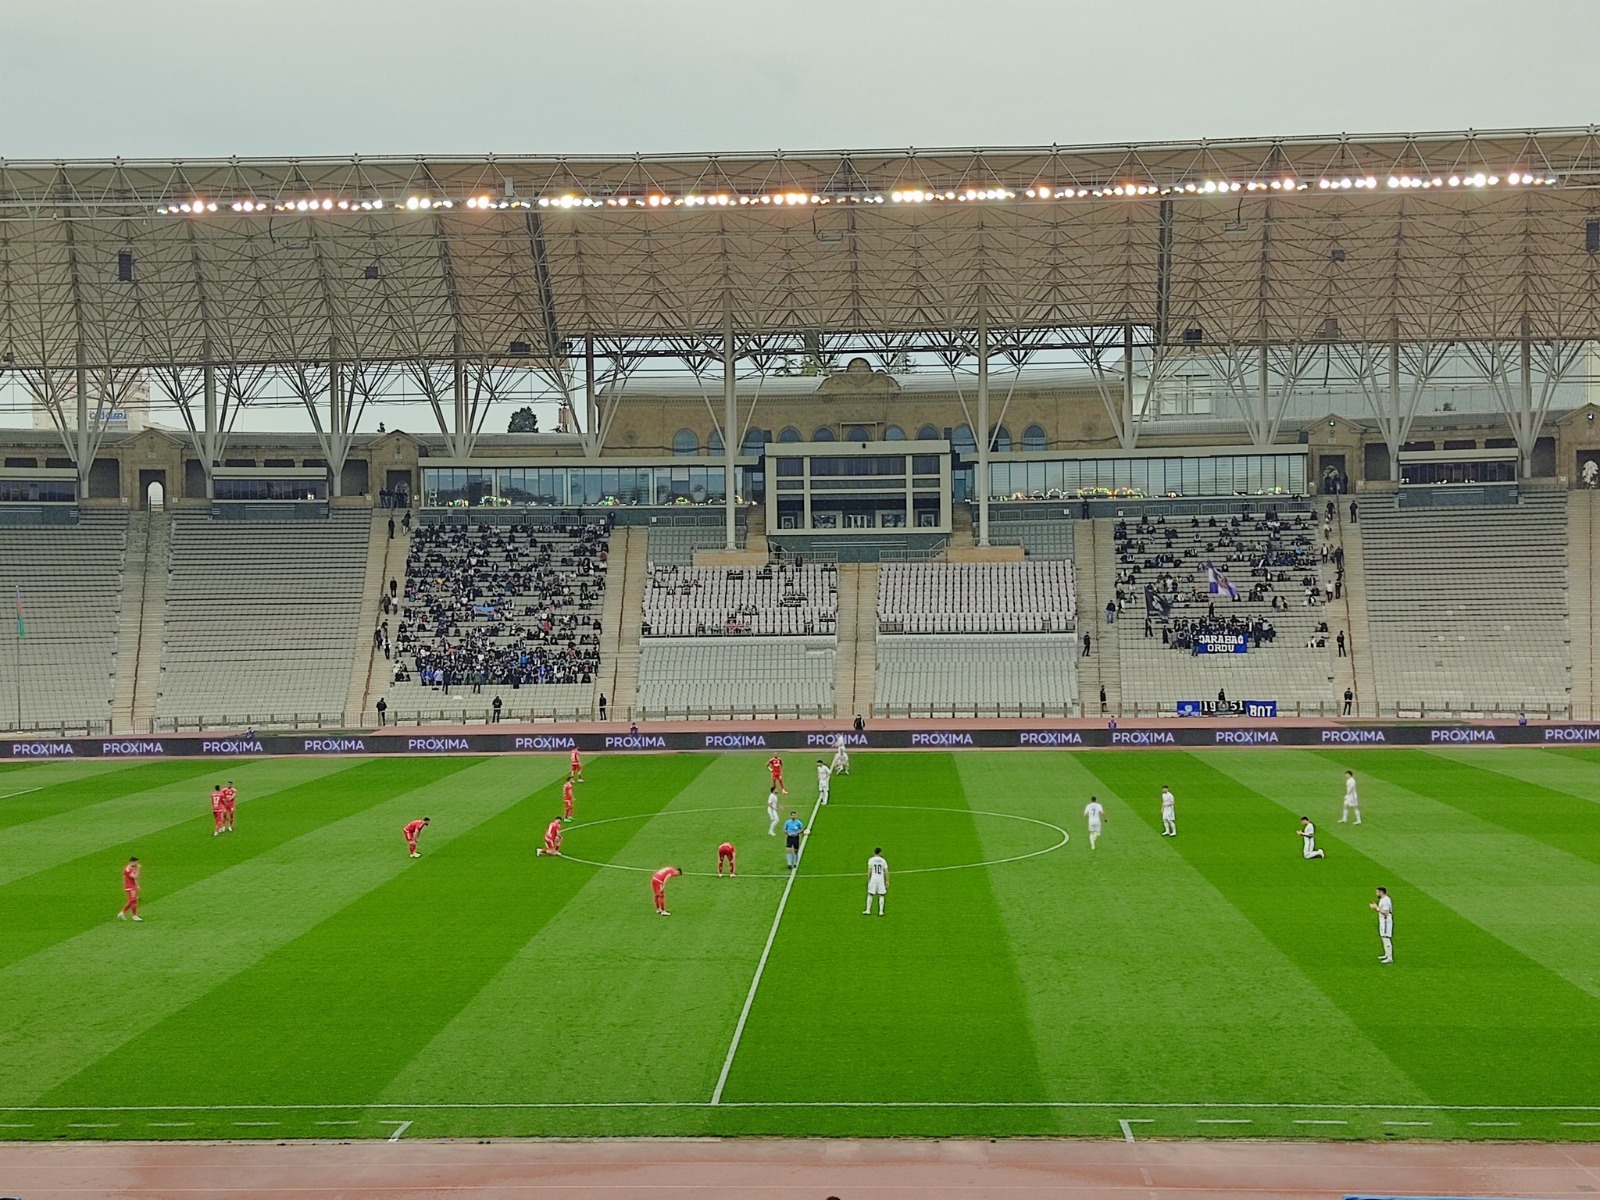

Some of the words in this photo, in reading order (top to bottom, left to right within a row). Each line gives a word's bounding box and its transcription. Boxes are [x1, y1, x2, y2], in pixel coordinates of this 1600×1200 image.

[1207, 644, 1235, 652] ORDU
[911, 733, 974, 744] PROXIMA
[1020, 732, 1083, 743] PROXIMA
[1111, 731, 1175, 742] PROXIMA
[1215, 731, 1279, 742] PROXIMA
[1321, 730, 1385, 741] PROXIMA
[1431, 729, 1496, 740] PROXIMA
[202, 741, 263, 752] PROXIMA
[304, 740, 365, 751] PROXIMA
[407, 738, 469, 749] PROXIMA
[515, 737, 577, 748] PROXIMA
[605, 737, 666, 747] PROXIMA
[704, 736, 766, 746] PROXIMA
[13, 744, 74, 755] PROXIMA
[102, 743, 164, 754] PROXIMA
[873, 863, 883, 874] 10
